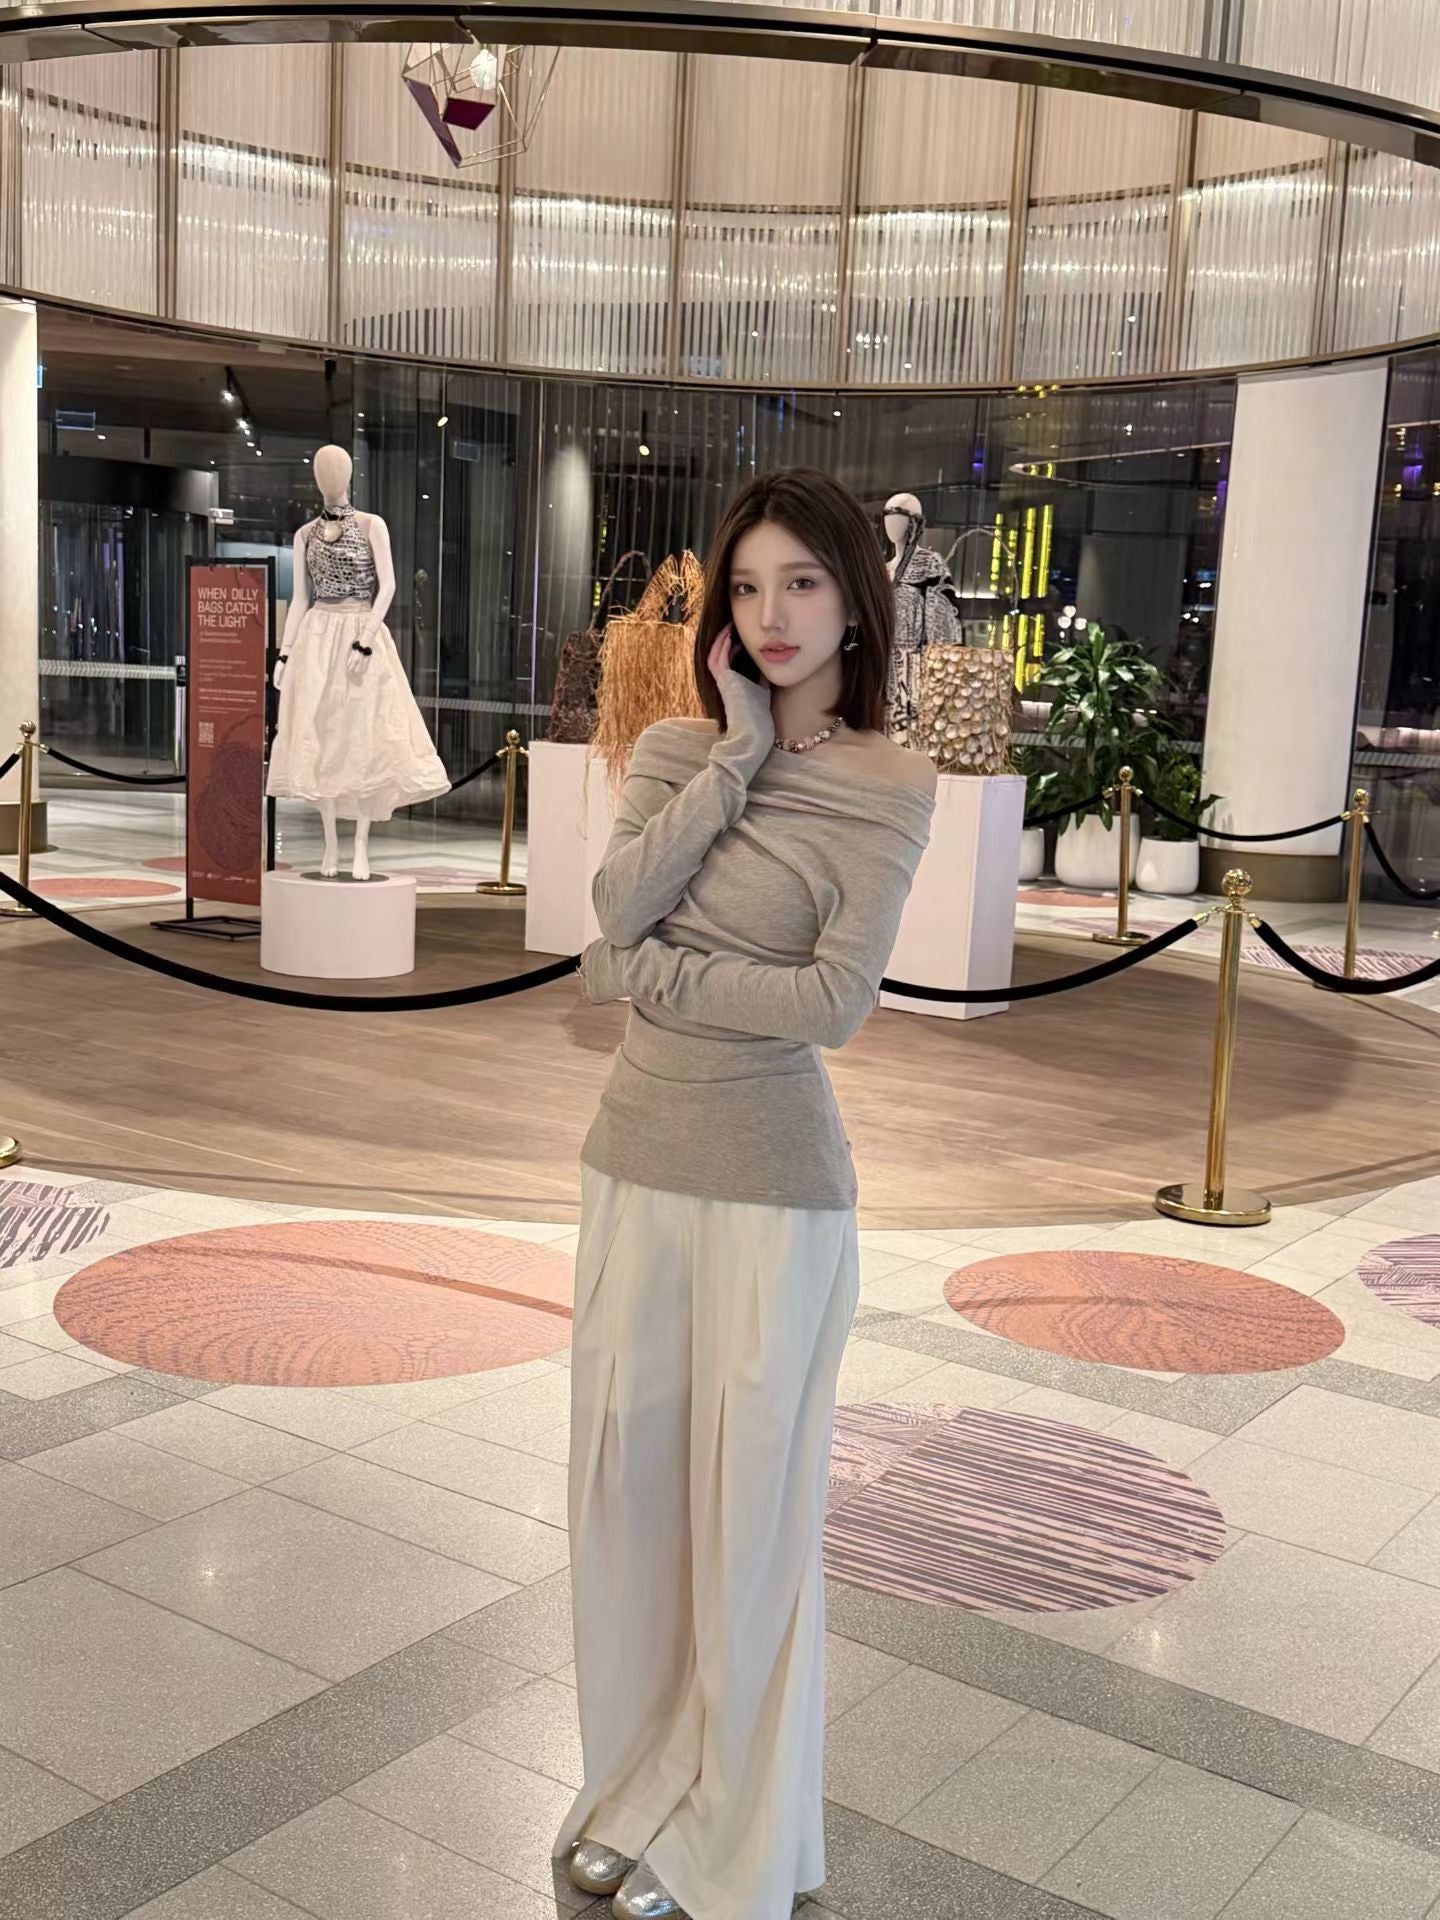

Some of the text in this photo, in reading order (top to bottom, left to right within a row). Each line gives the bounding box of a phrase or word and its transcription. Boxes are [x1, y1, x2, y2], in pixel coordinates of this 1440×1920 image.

[197, 587, 258, 600] WHEN DILLY
[197, 601, 259, 615] BAGS CATCH
[197, 615, 248, 628] THE LIGHT
